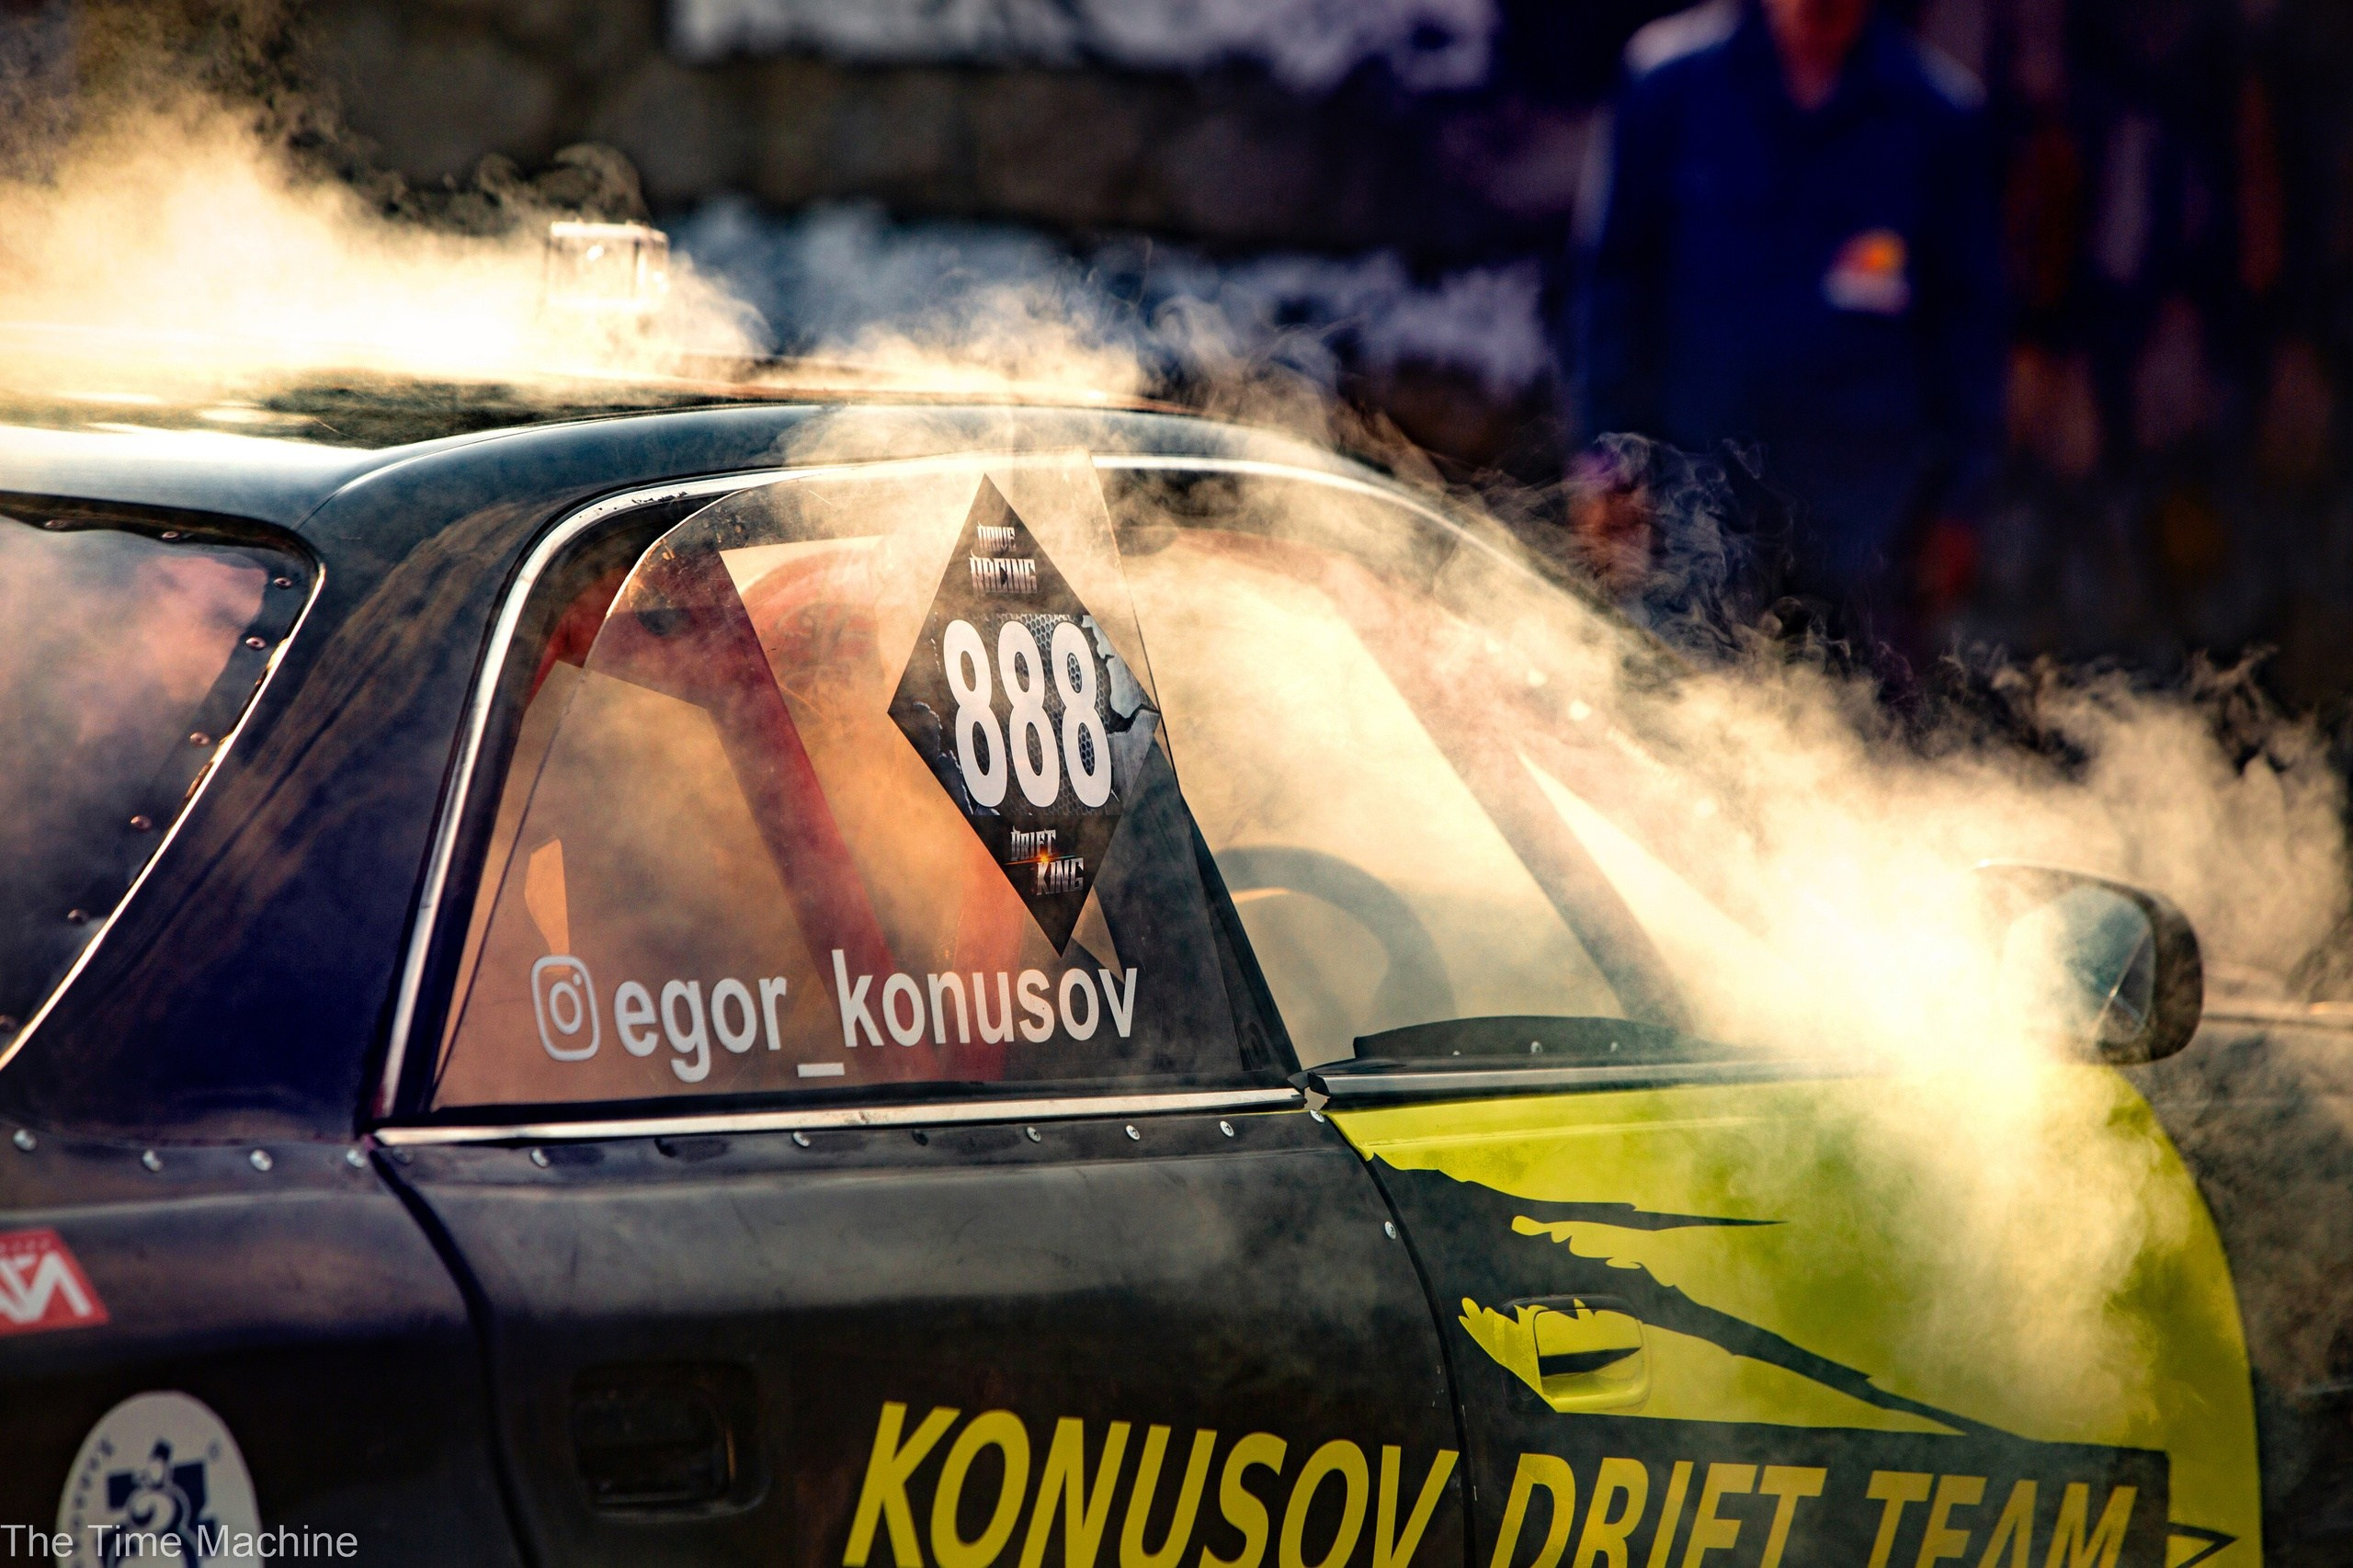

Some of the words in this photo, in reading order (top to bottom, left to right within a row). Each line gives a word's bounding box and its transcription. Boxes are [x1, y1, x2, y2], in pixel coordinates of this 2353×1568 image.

[976, 519, 1017, 551] DRIVE
[969, 549, 1038, 595] RACING
[943, 619, 1112, 808] 888
[1010, 825, 1056, 861] DRIFT
[1036, 858, 1084, 896] KING
[614, 949, 1138, 1083] egor_konusov
[842, 1401, 1460, 1568] KONUSOV
[1491, 1452, 1827, 1568] DRIFT
[1866, 1469, 2138, 1568] TEAM
